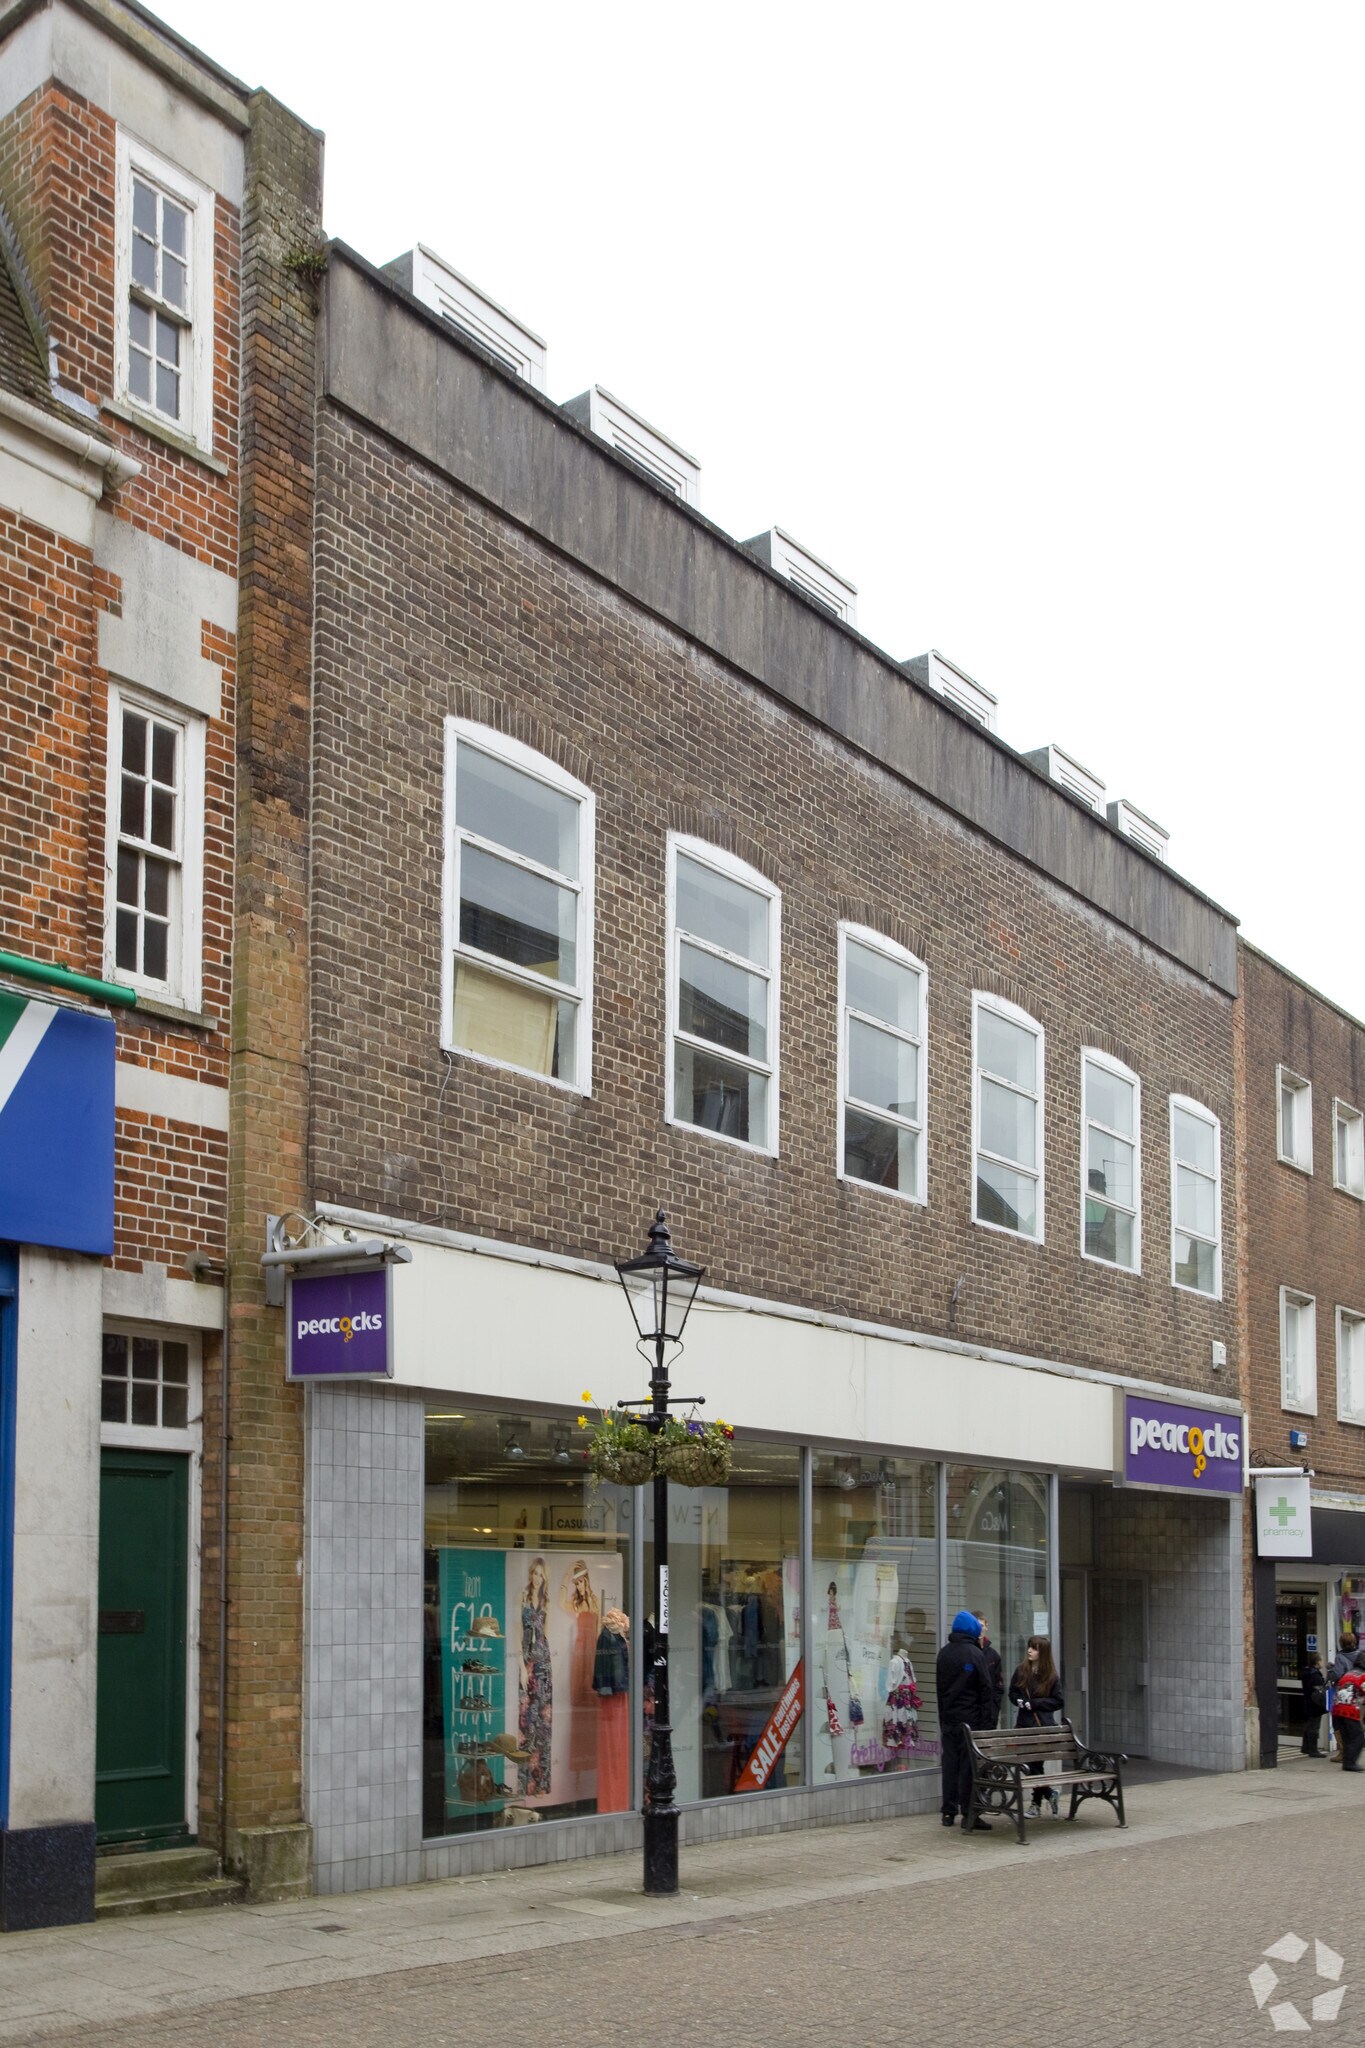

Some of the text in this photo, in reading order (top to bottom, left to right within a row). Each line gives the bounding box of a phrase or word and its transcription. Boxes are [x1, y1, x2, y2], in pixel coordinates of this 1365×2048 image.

[297, 1311, 382, 1341] peacocks
[1130, 1416, 1240, 1463] peacocks
[556, 1518, 600, 1530] CASUALS
[1263, 1527, 1304, 1537] pharmacy
[773, 1677, 801, 1727] continues
[778, 1698, 801, 1741] instore
[750, 1724, 783, 1785] SALE
